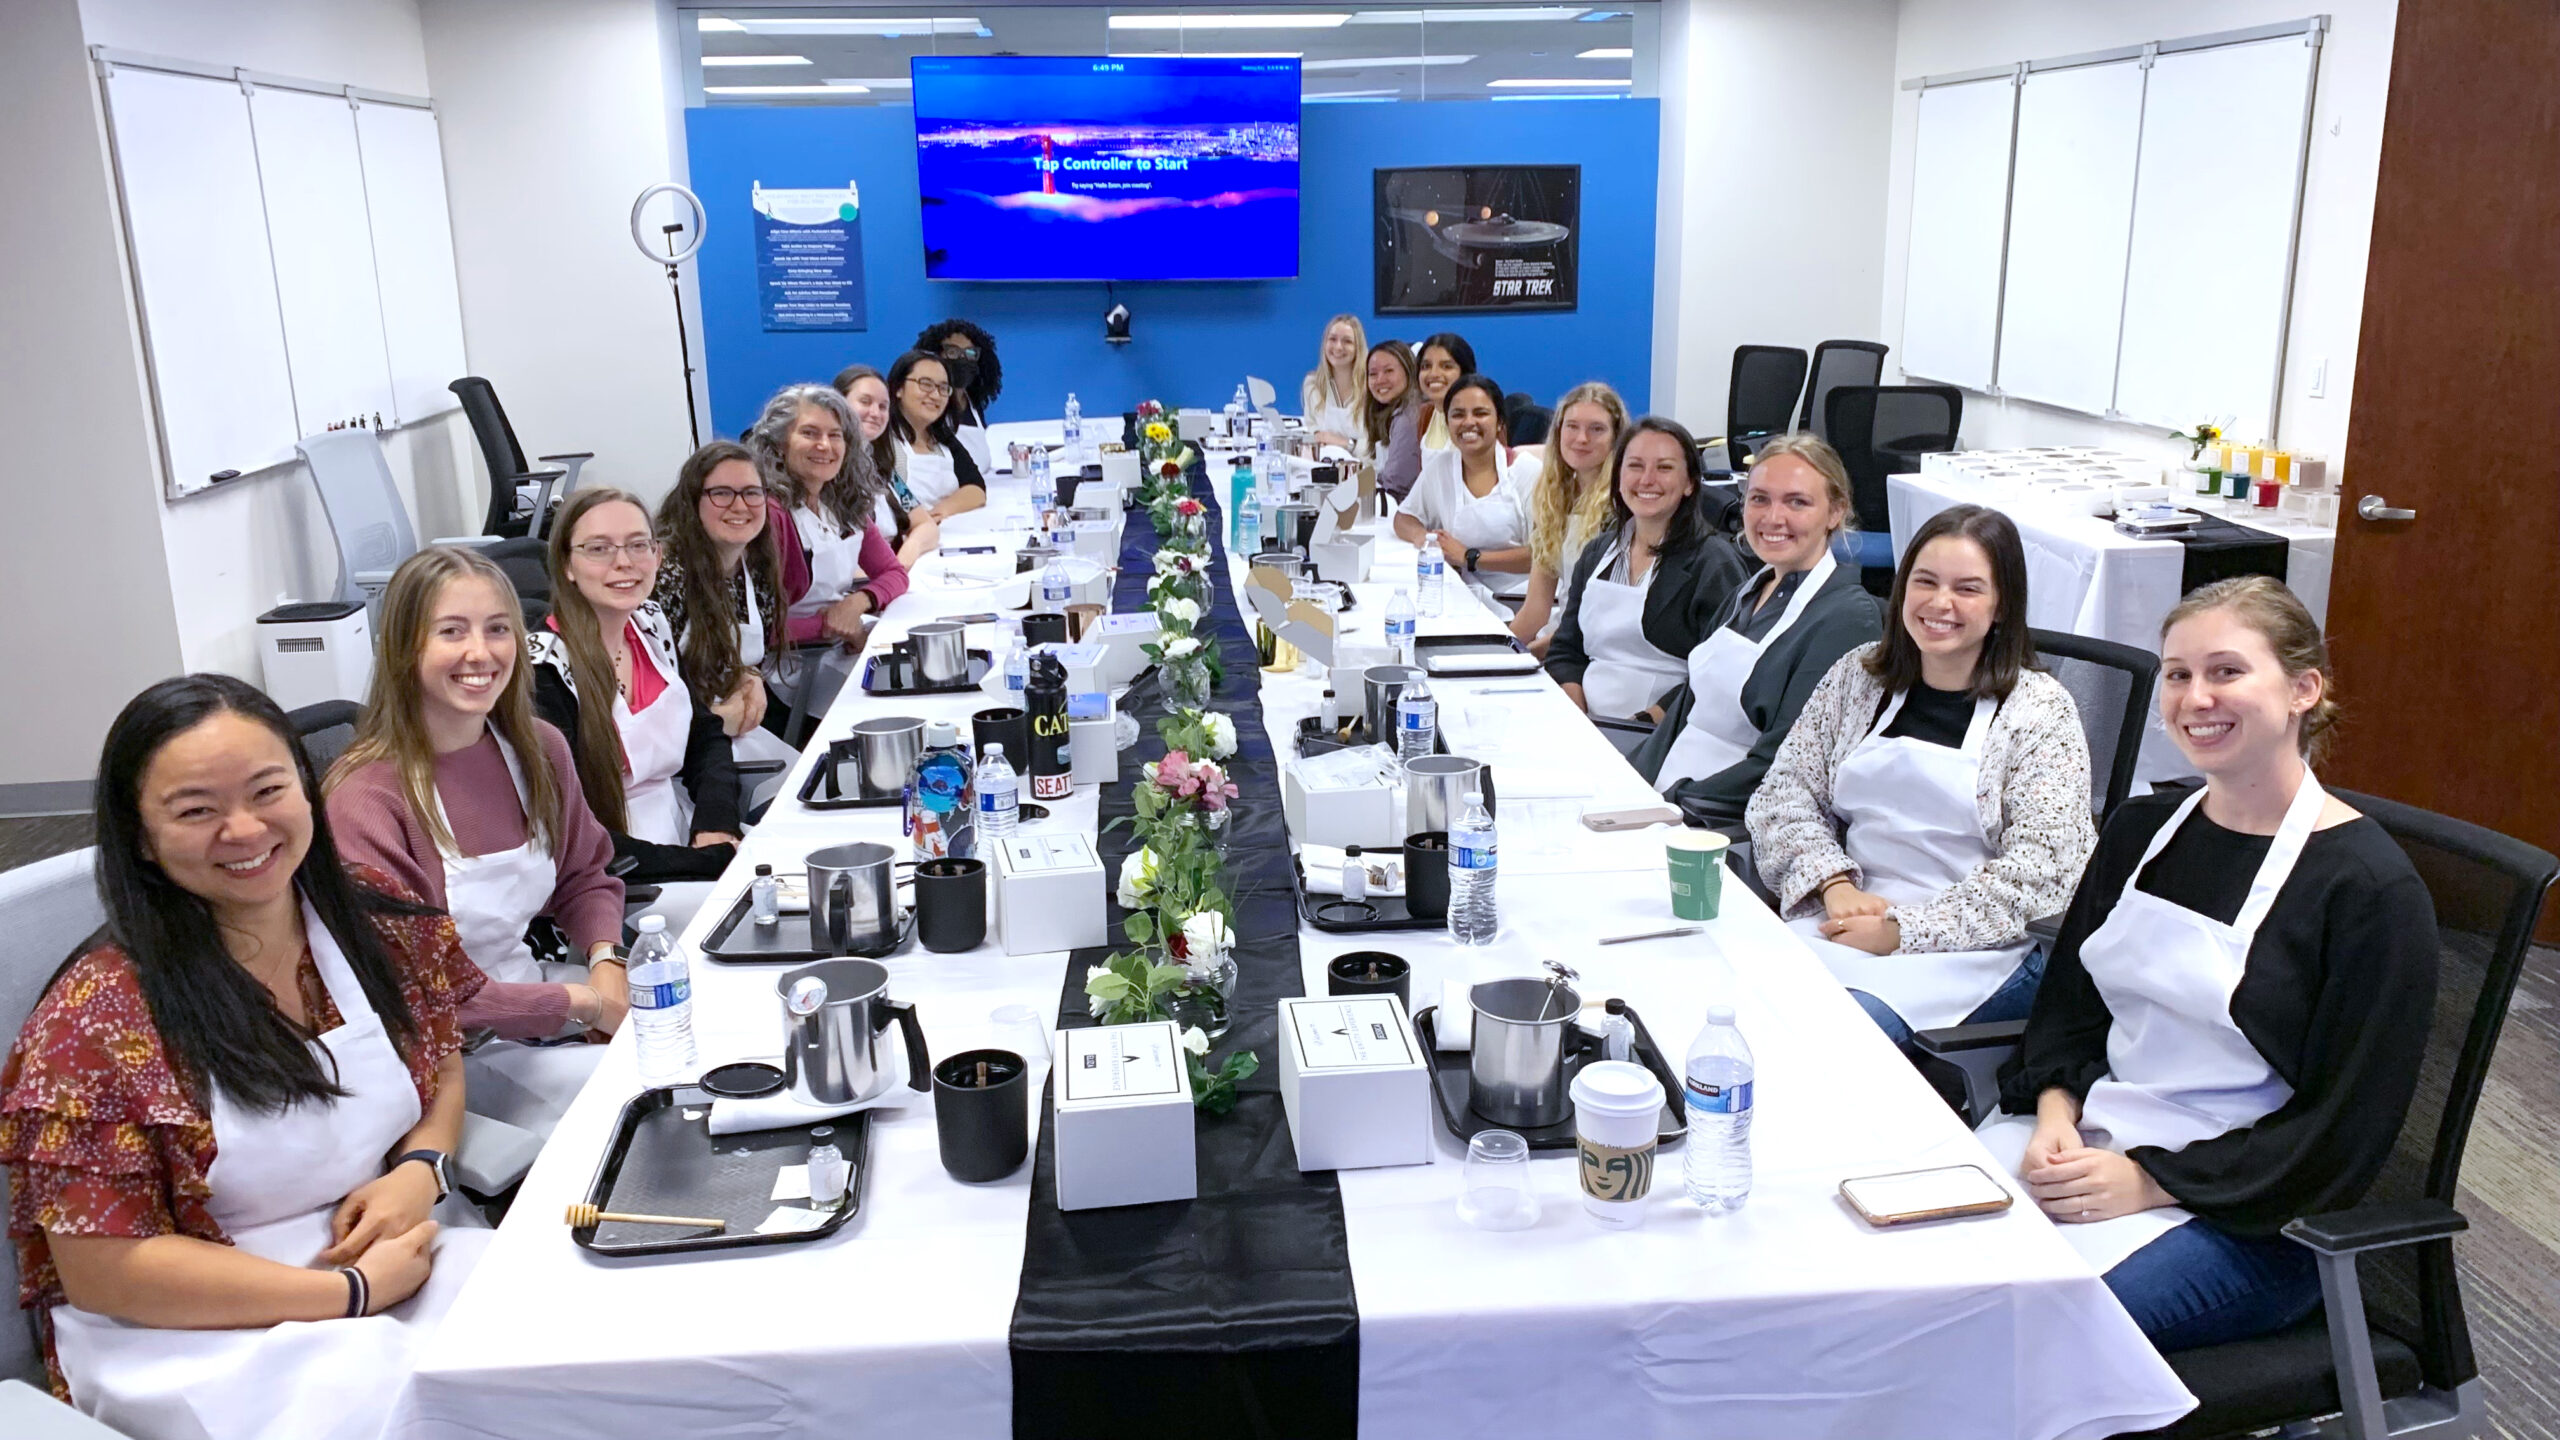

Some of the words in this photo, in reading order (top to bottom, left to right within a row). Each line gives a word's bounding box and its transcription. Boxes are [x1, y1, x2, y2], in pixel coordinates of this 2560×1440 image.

[1093, 63, 1109, 72] 6:49
[1111, 63, 1124, 72] PM
[1033, 157, 1059, 174] Tap
[1063, 156, 1133, 170] Controller
[1136, 158, 1151, 170] to
[1155, 156, 1188, 170] Start
[1493, 279, 1522, 296] STAR
[1525, 279, 1554, 296] TREK
[1688, 1078, 1719, 1093] KIRKLAND
